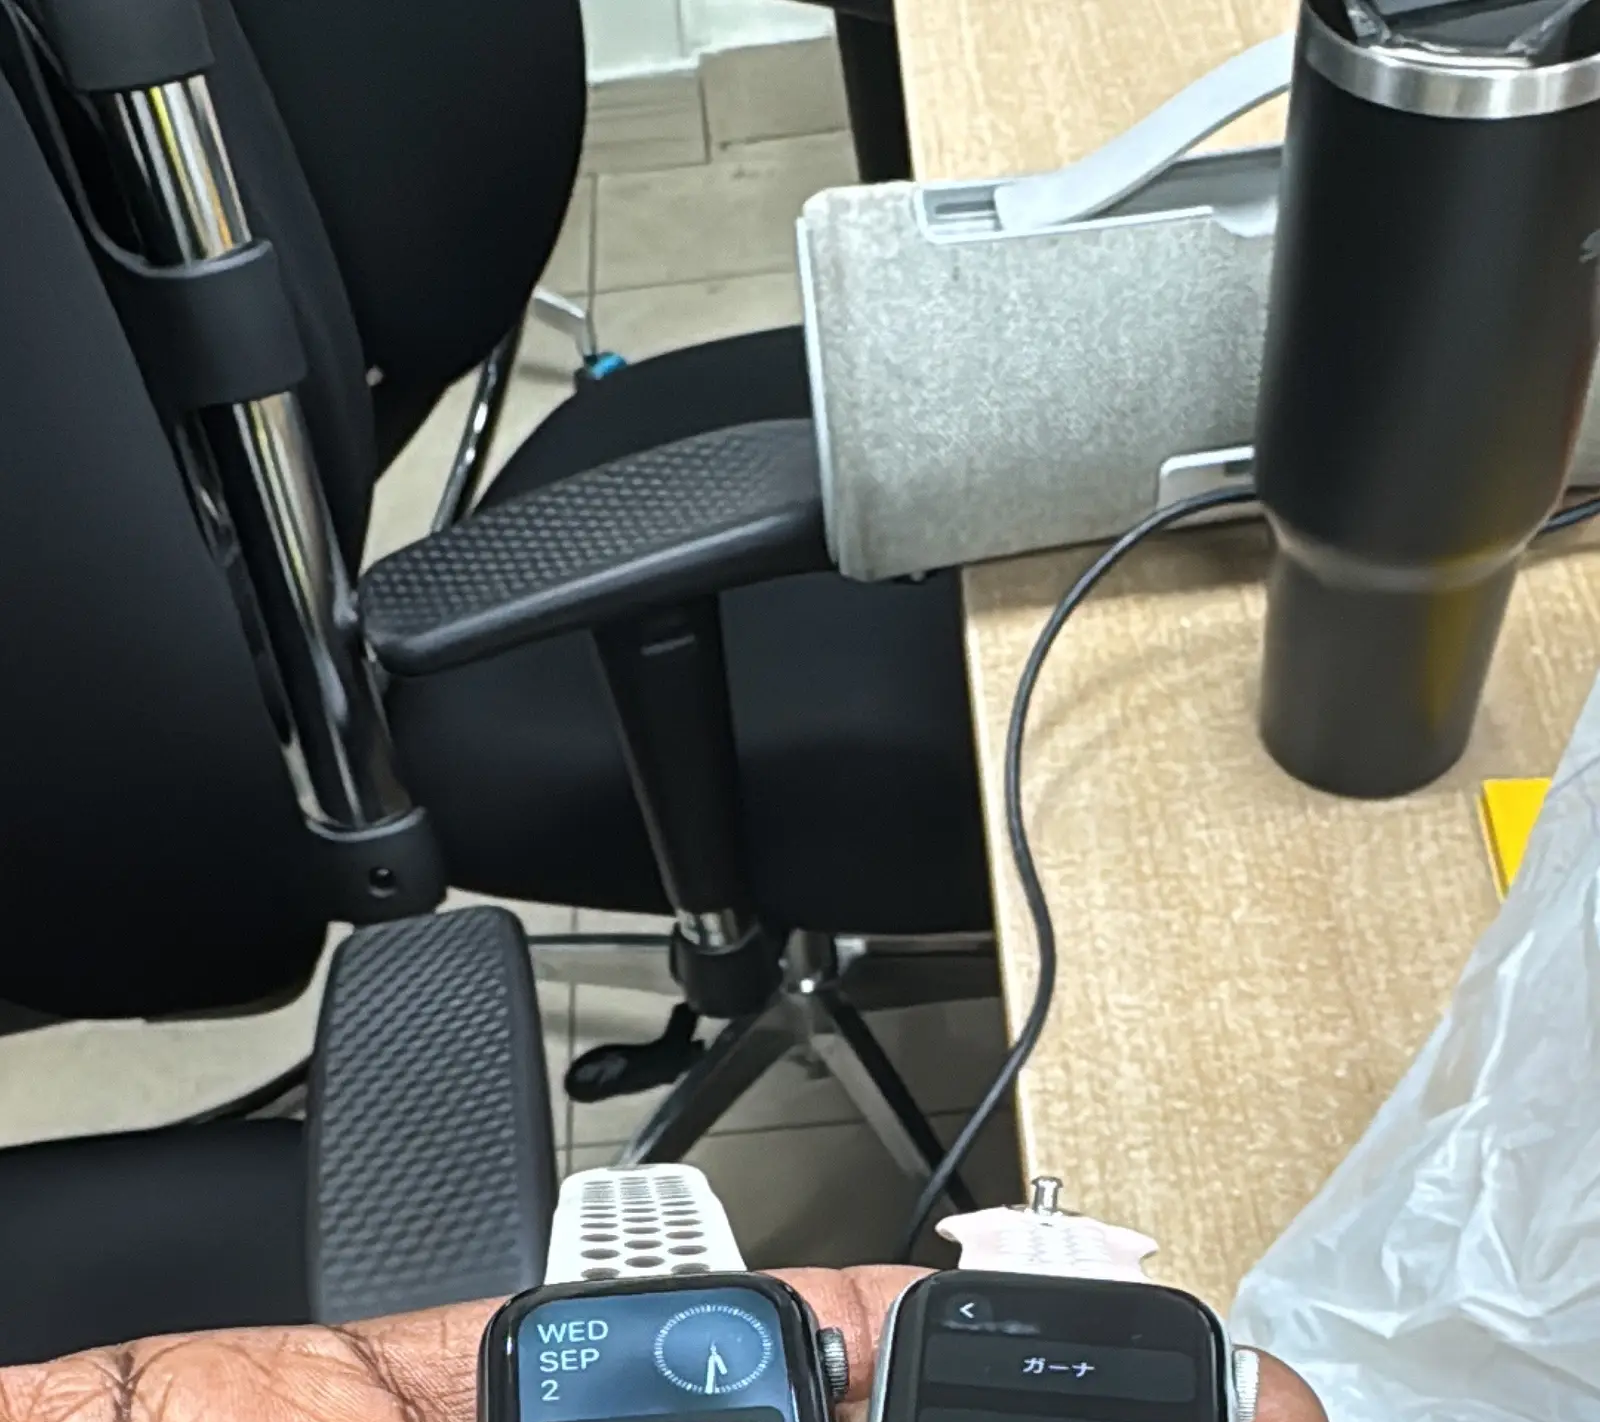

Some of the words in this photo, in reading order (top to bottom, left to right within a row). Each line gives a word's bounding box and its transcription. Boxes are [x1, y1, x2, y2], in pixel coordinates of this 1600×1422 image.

[537, 1319, 609, 1345] WED
[539, 1348, 600, 1373] SEP
[1022, 1357, 1095, 1378] ガーナ
[541, 1379, 560, 1402] 2
